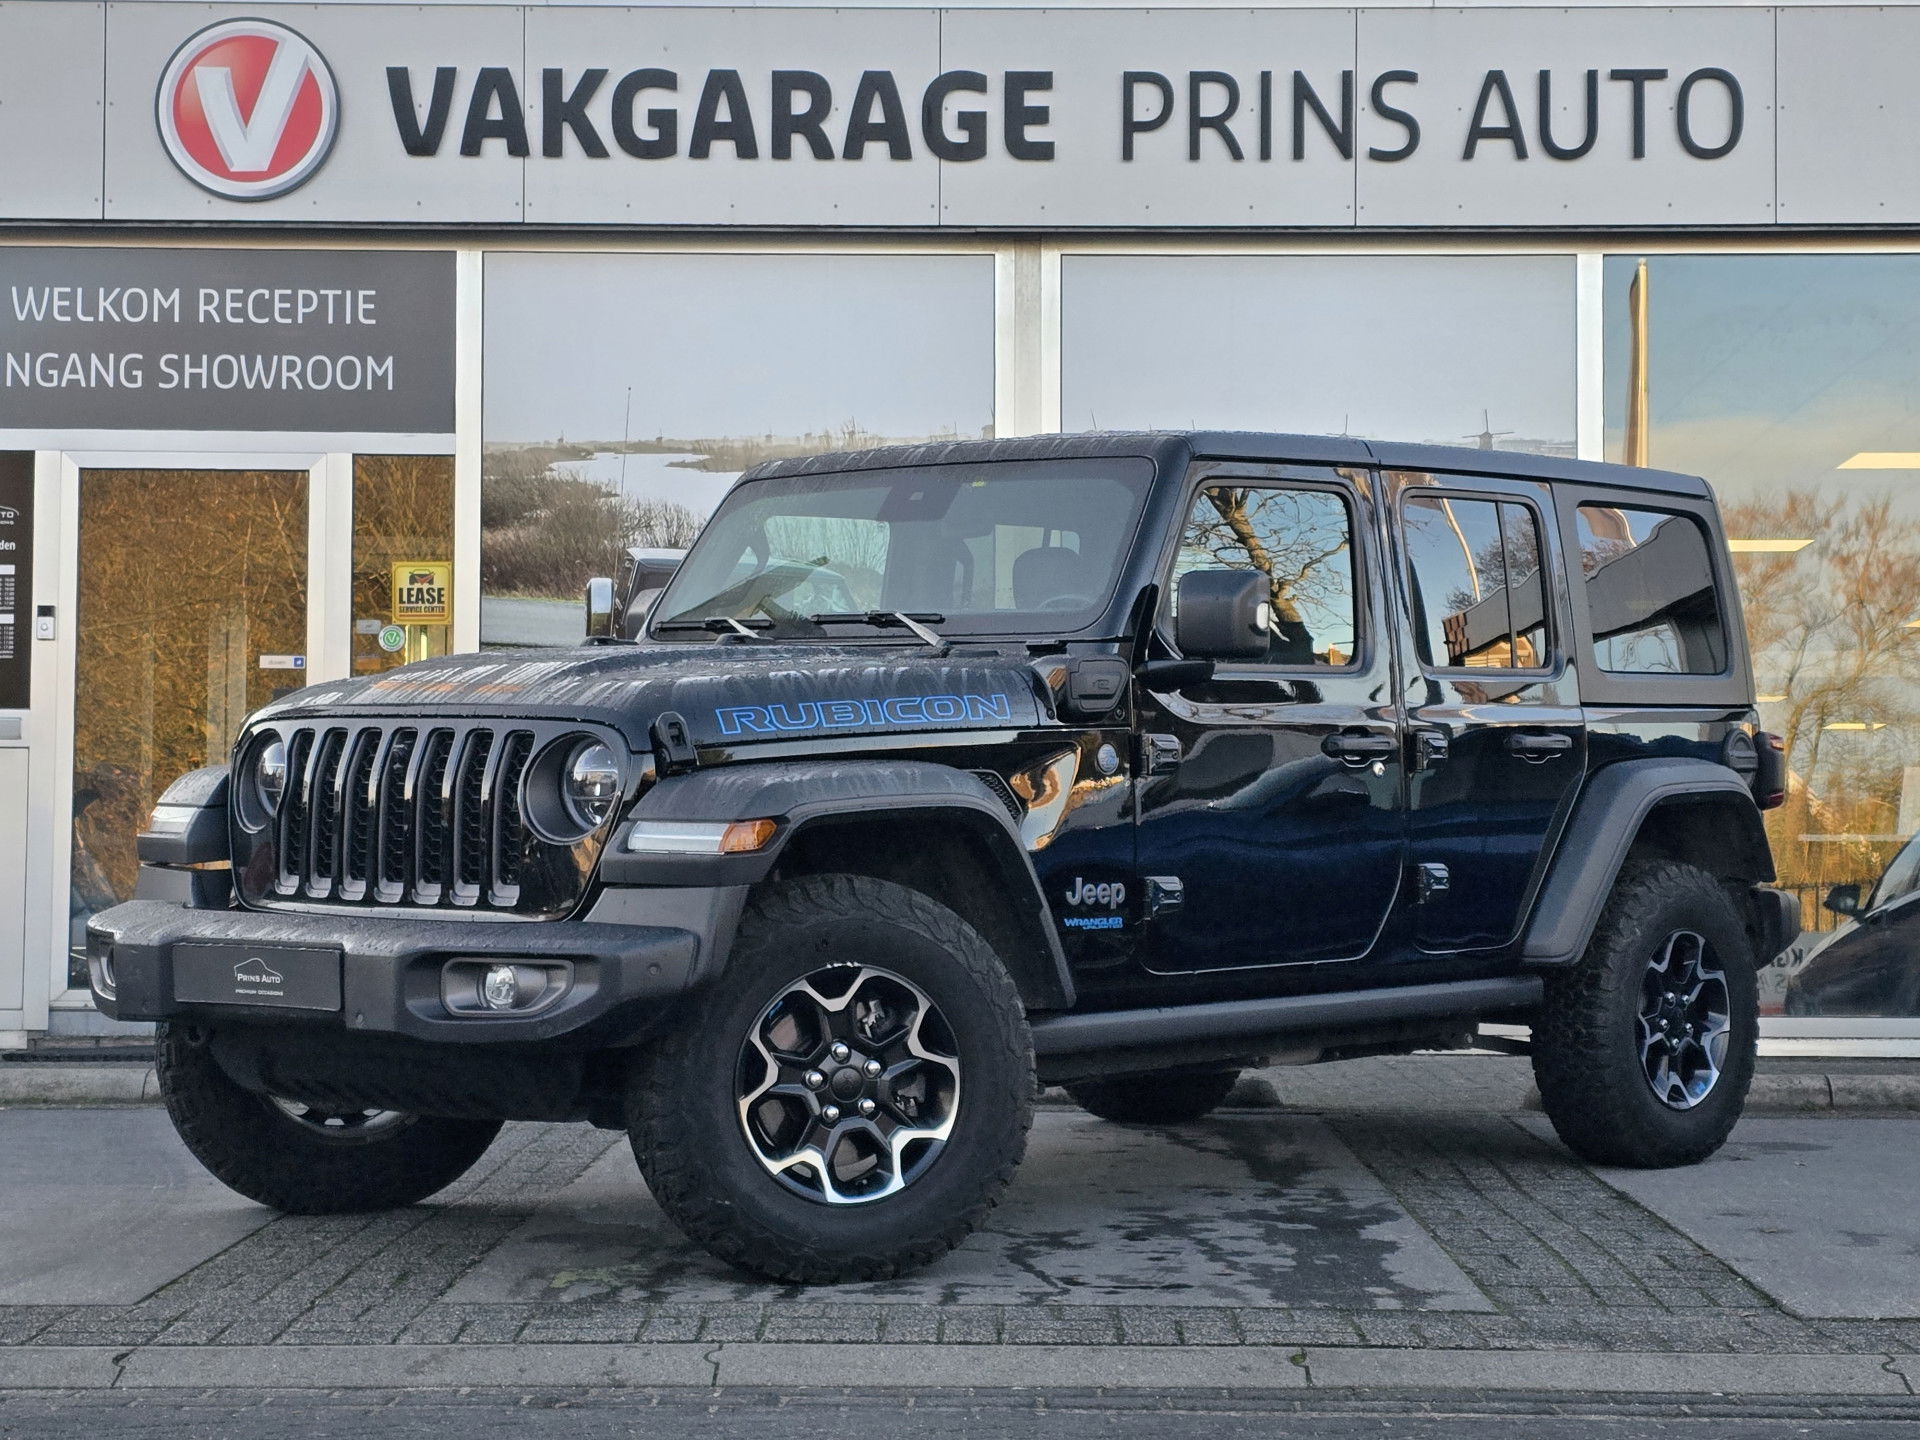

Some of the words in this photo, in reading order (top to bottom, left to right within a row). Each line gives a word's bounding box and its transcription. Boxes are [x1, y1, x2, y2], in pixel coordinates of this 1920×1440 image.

[385, 66, 1056, 162] VAKGARAGE
[1122, 69, 1421, 162] PRINS
[1462, 67, 1745, 161] AUTO
[11, 286, 181, 323] WELKOM
[198, 288, 377, 325] RECEPTIE
[5, 351, 144, 389] NGANG
[158, 354, 395, 391] SHOWROOM
[398, 587, 445, 605] LEASE
[714, 693, 1011, 735] RUBICON
[1065, 876, 1126, 910] Jeep
[1063, 916, 1124, 927] WRANGLER
[261, 974, 281, 983] AUTO
